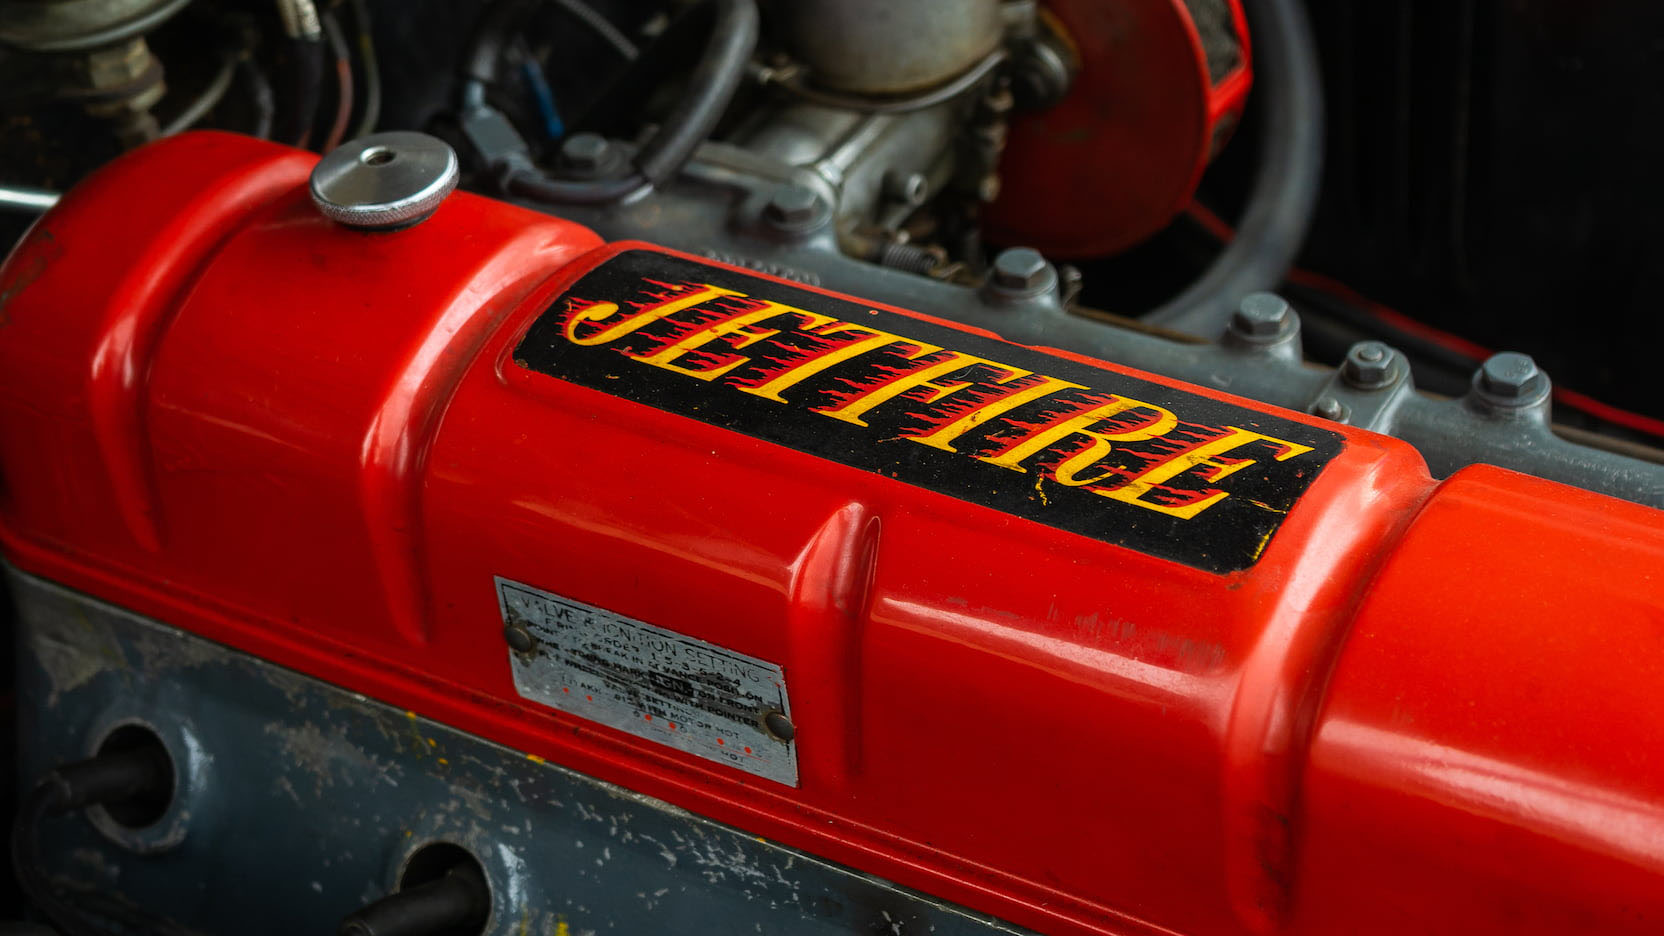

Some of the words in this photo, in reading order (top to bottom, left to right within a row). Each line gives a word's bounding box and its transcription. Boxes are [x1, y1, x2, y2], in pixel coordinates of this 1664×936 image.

[564, 280, 1315, 520] JETFIRE
[685, 648, 760, 683] SETTING
[697, 688, 714, 701] ON
[718, 696, 760, 714] FRONT
[670, 711, 712, 730] MOTOR
[706, 705, 759, 727] POINTER
